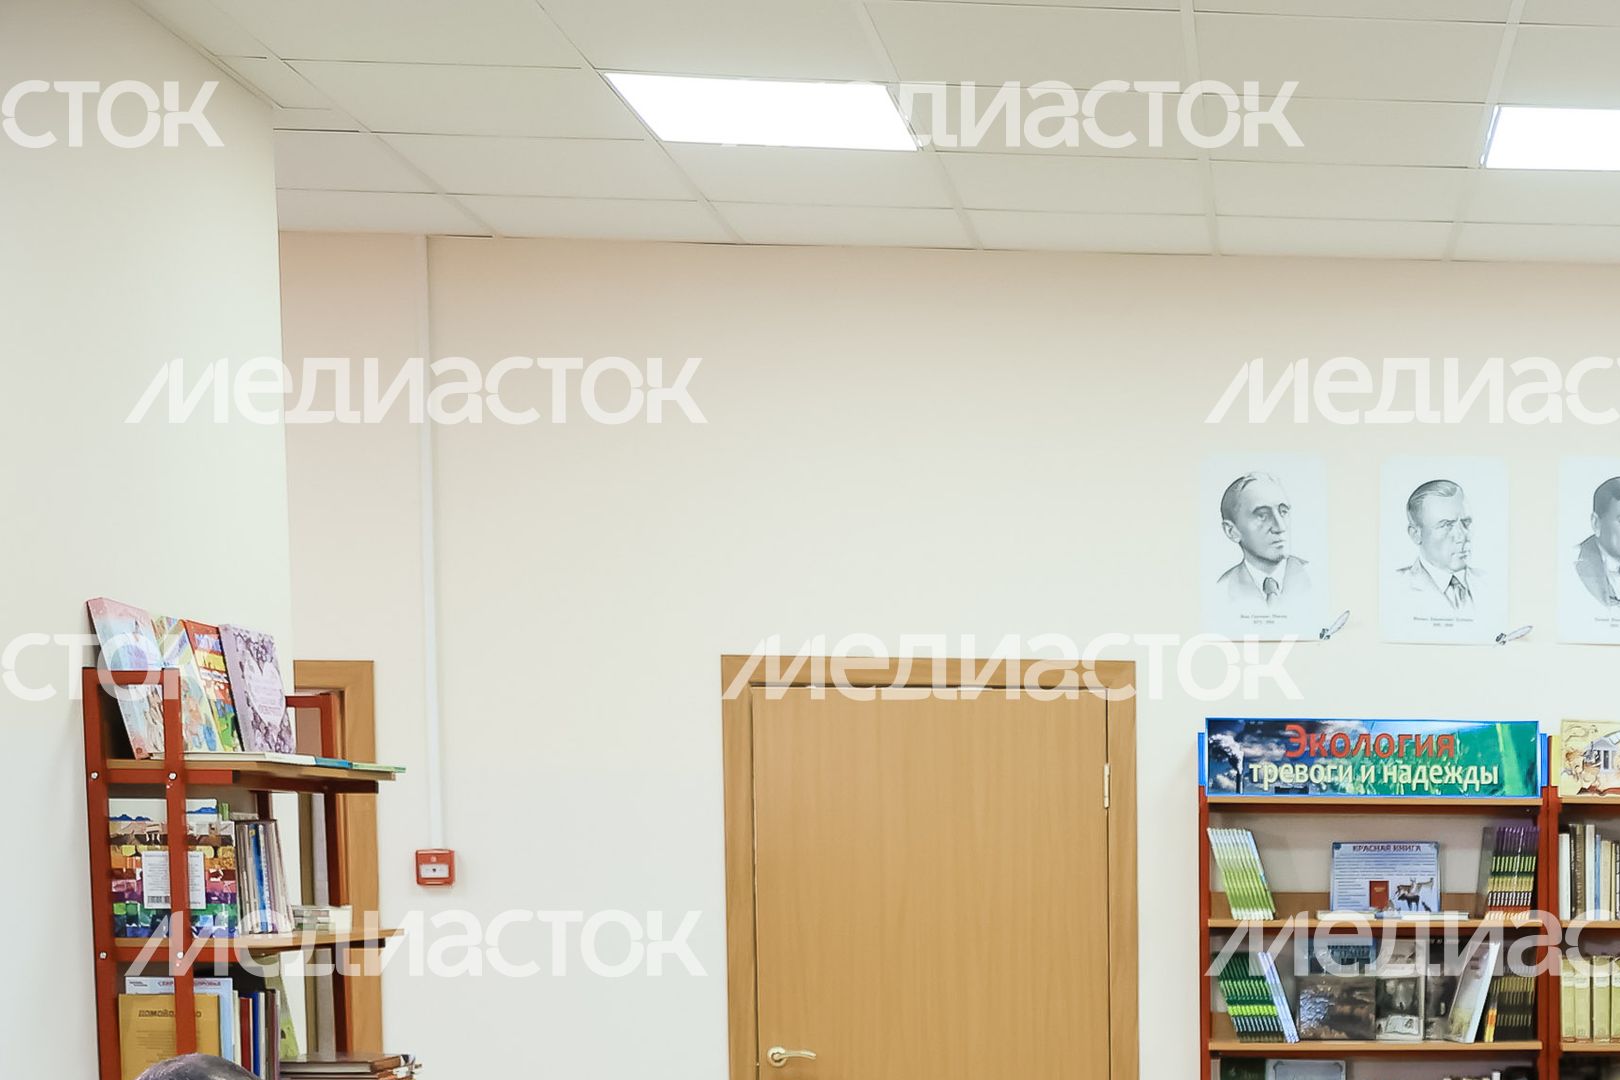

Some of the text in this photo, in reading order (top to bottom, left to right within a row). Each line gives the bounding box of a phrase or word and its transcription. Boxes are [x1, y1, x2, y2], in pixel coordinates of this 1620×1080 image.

[1285, 724, 1456, 758] Экология
[1249, 763, 1498, 792] тревоги и надежды
